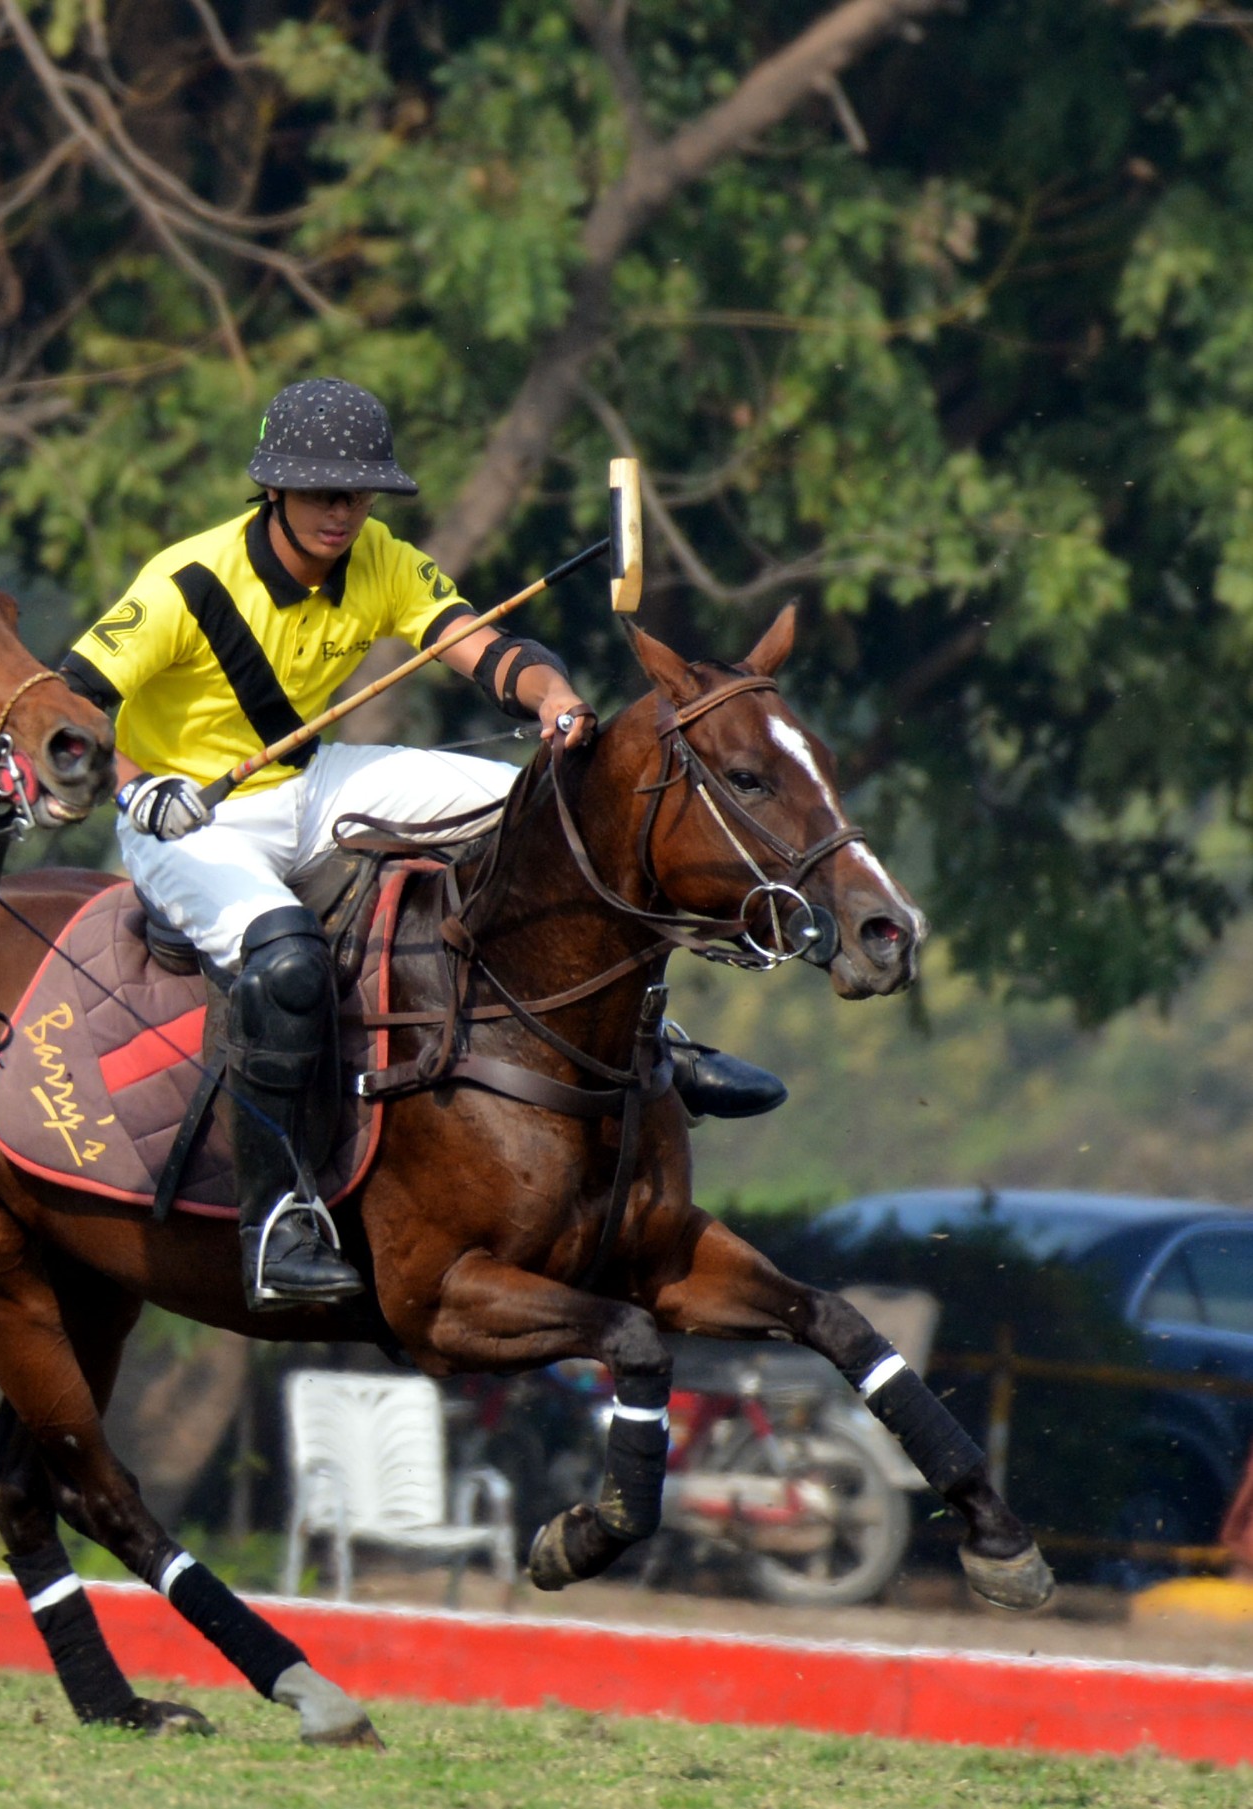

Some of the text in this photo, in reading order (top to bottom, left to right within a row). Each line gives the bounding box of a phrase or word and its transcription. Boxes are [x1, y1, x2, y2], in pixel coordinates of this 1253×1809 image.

[416, 560, 457, 602] 2
[87, 597, 147, 657] 2
[23, 1002, 116, 1167] Barry's
